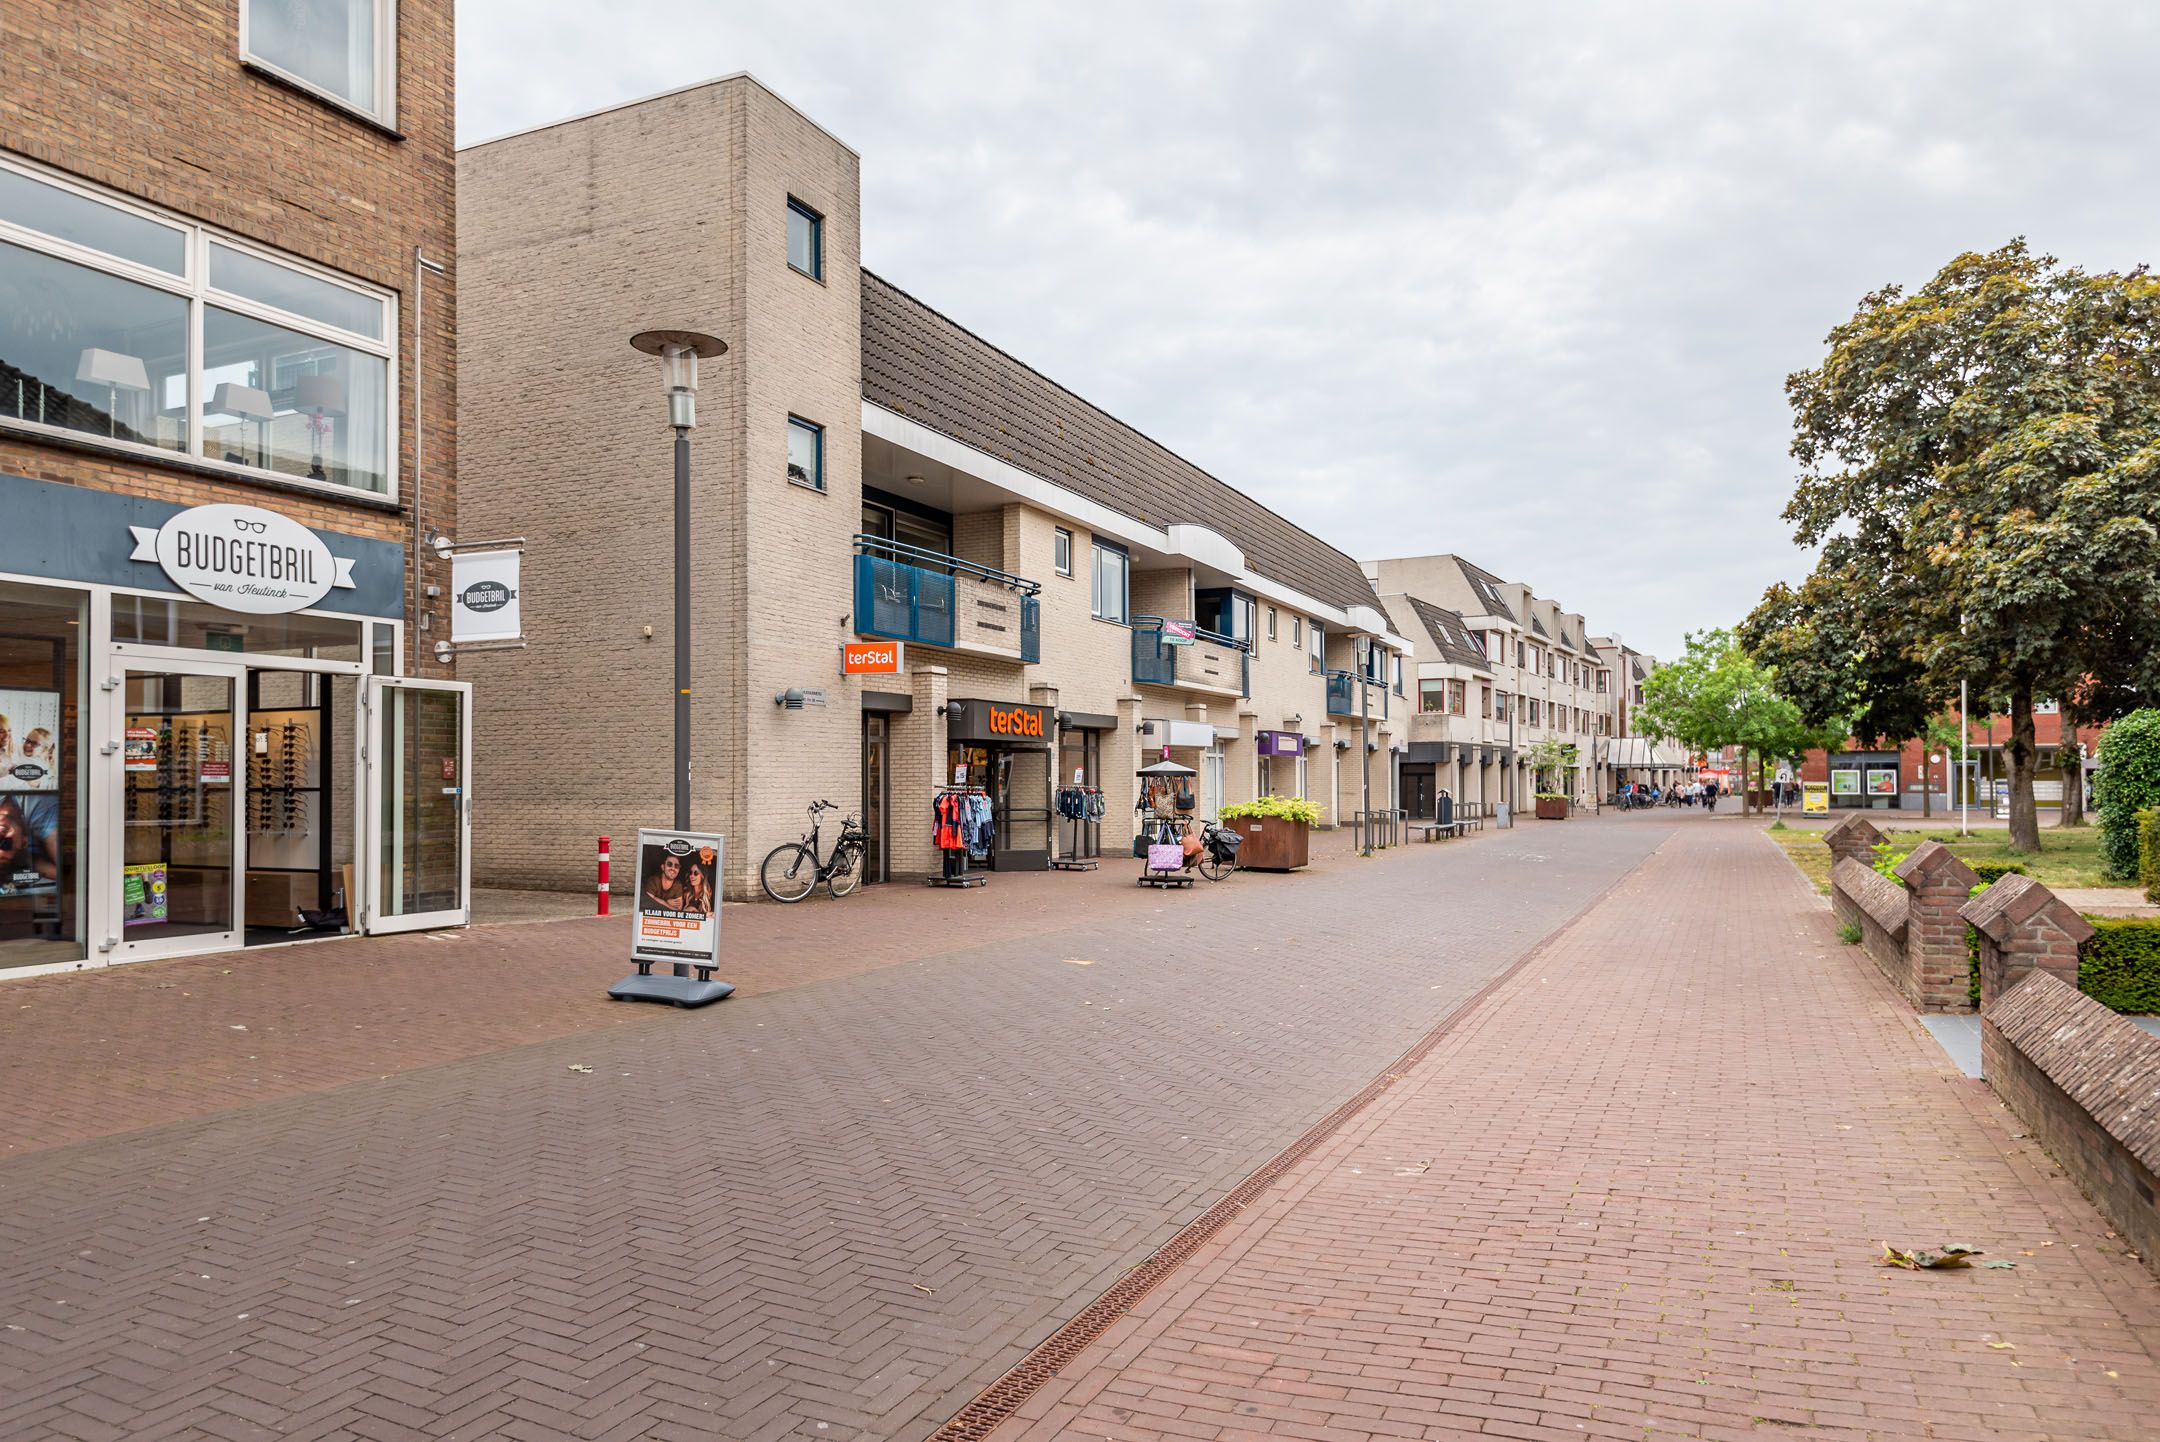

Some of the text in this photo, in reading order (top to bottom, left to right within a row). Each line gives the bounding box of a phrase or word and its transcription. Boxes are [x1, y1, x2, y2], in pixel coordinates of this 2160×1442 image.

[178, 530, 317, 584] BUDGETBRIL
[213, 583, 288, 599] van Heutinck
[466, 590, 506, 604] BUDGETBRIL
[848, 650, 894, 665] terStal
[989, 706, 1044, 737] terStal
[662, 910, 677, 918] VOOR
[685, 912, 705, 920] ZOMER!
[643, 927, 678, 937] BUDGETPRIJS
